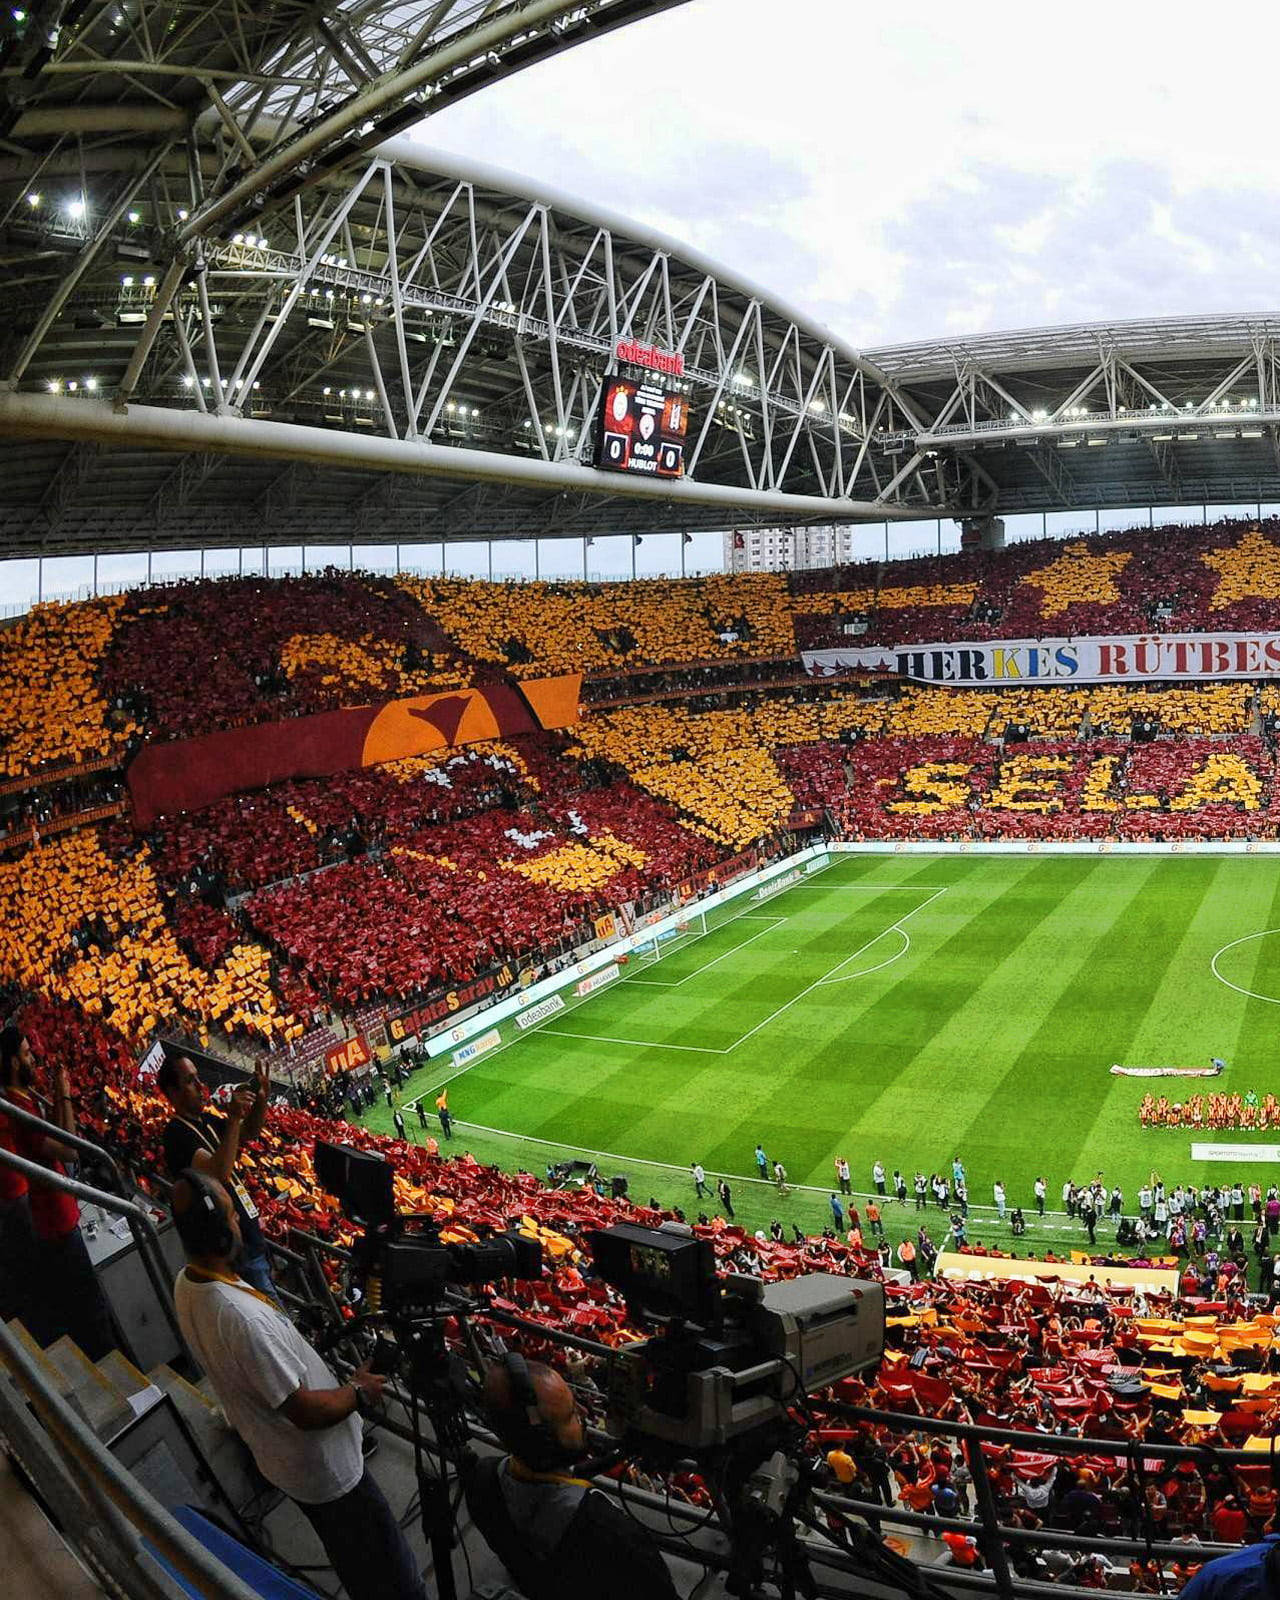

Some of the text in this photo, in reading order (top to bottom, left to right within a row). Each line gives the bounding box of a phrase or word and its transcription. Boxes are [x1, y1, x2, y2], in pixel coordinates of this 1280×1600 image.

[616, 339, 685, 376] odeabank
[610, 440, 621, 459] 0
[665, 450, 676, 468] 0
[627, 457, 658, 471] HUBLOT
[895, 645, 1079, 680] HERKES
[597, 917, 614, 939] uA
[520, 995, 564, 1027] odeabank
